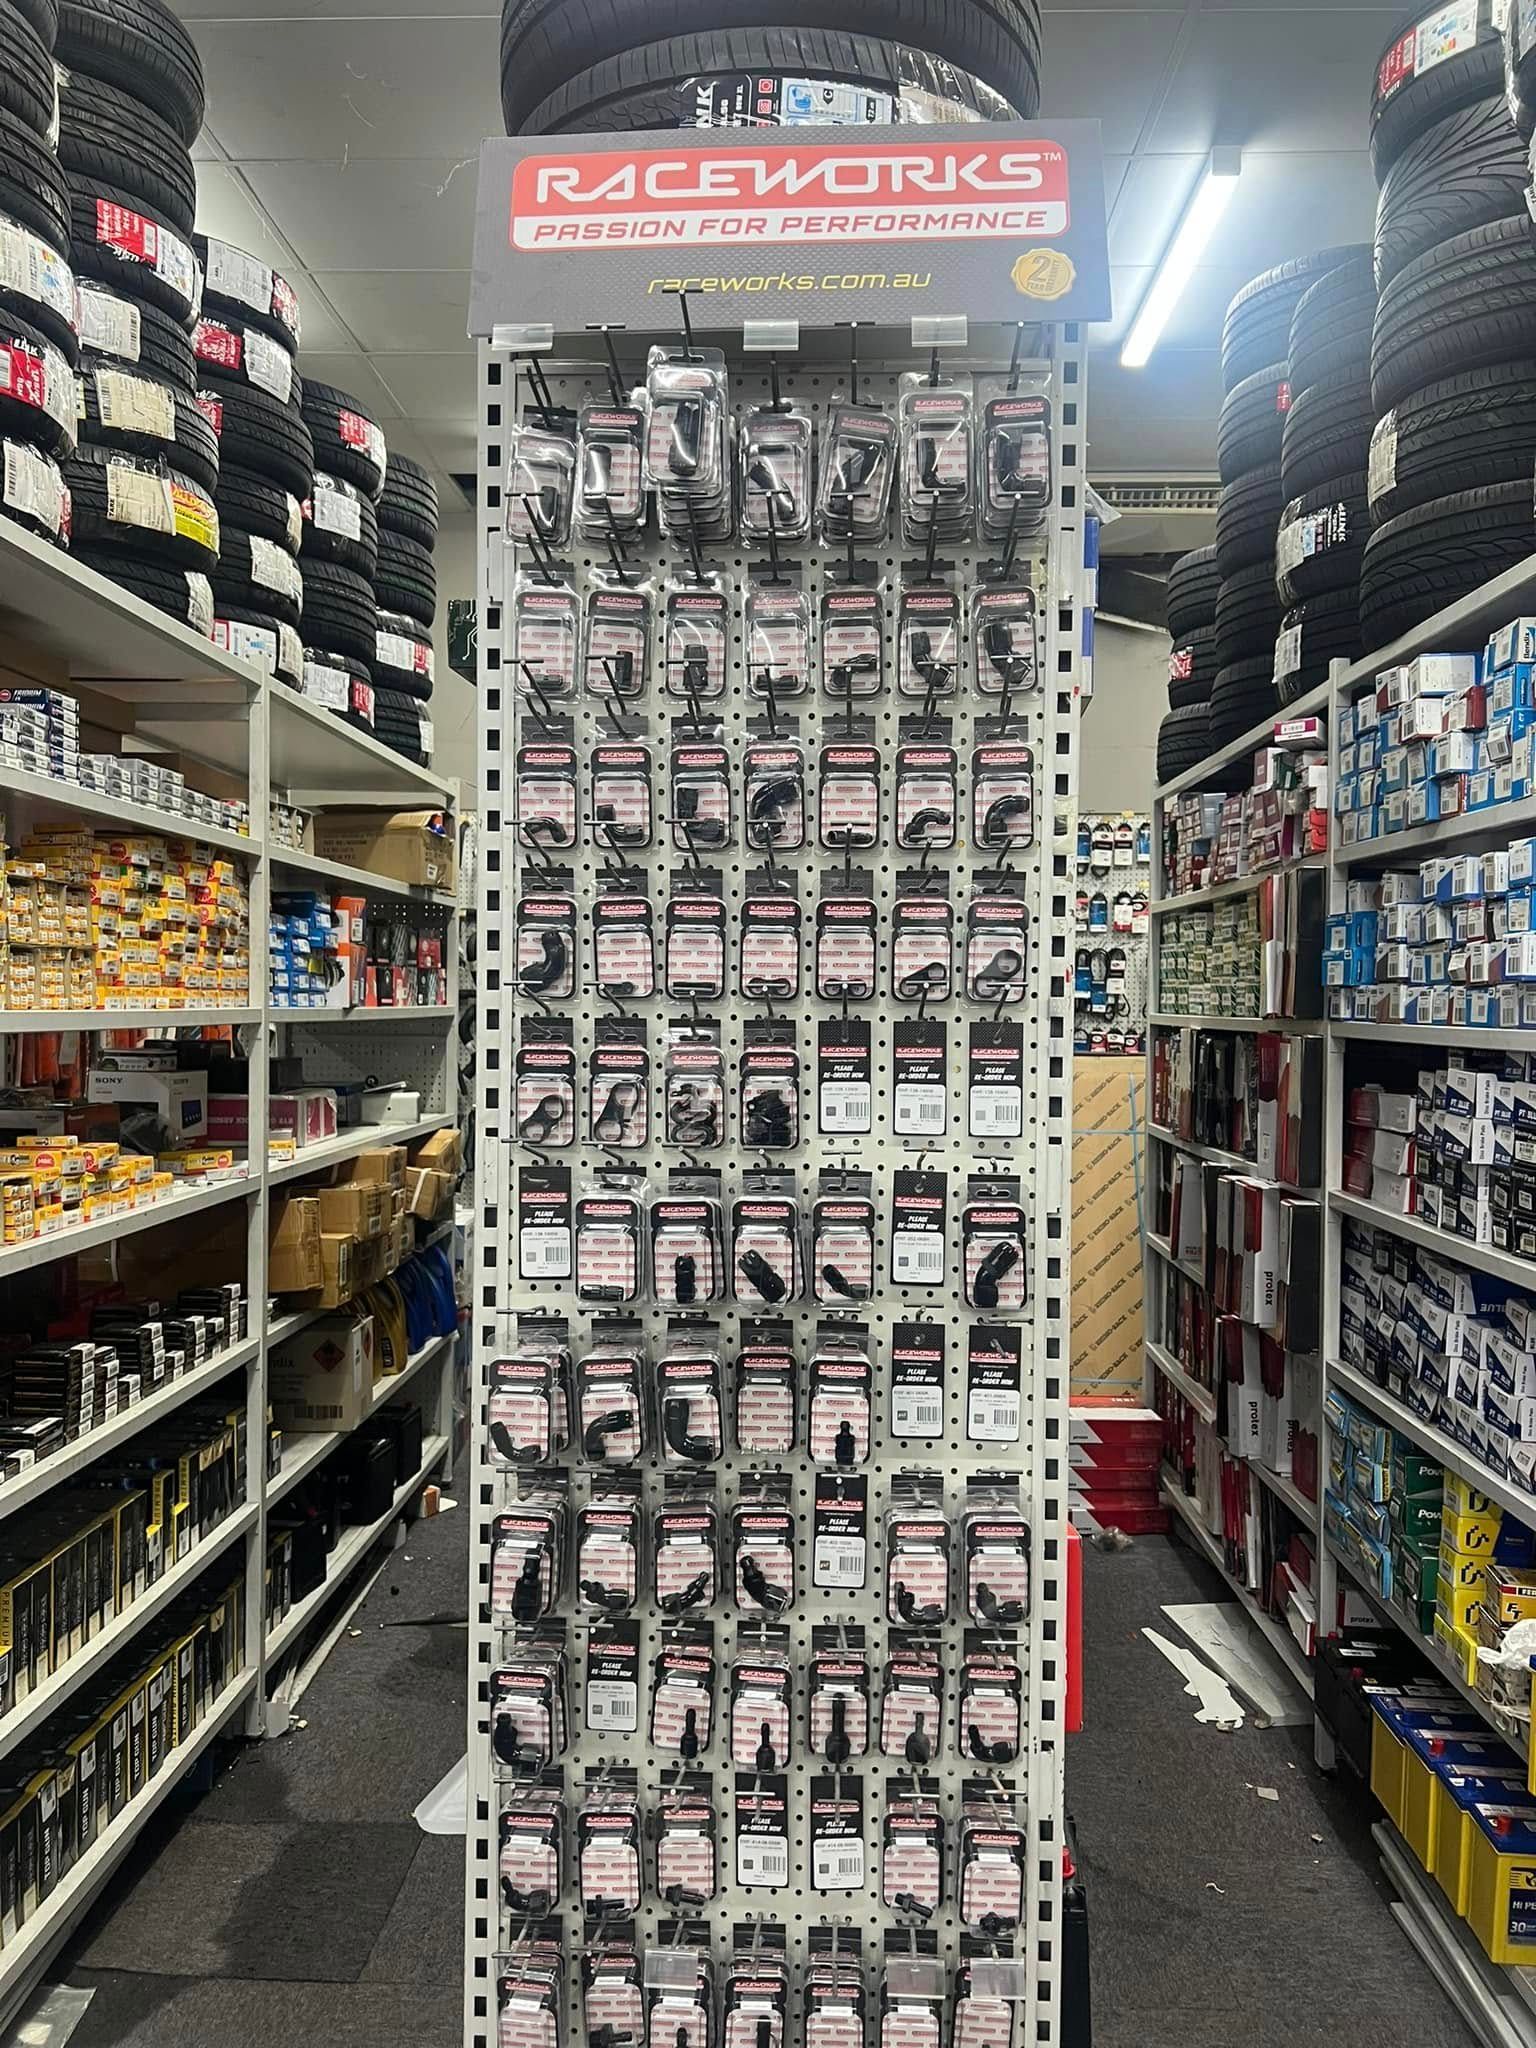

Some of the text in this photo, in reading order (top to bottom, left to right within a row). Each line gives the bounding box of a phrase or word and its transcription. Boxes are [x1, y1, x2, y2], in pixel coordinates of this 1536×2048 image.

[537, 153, 1042, 203] RACEWORKS
[534, 210, 1047, 242] PASSION FOR PERFORMANCE
[1027, 255, 1050, 281] 2
[647, 271, 931, 294] raceworks.com.au
[1264, 1271, 1273, 1306] protex
[1250, 1401, 1260, 1437] protex
[1419, 1466, 1444, 1476] Pow
[1418, 1509, 1442, 1519] Pow
[1524, 1901, 1536, 1911] PE
[1509, 1921, 1527, 1933] 30
